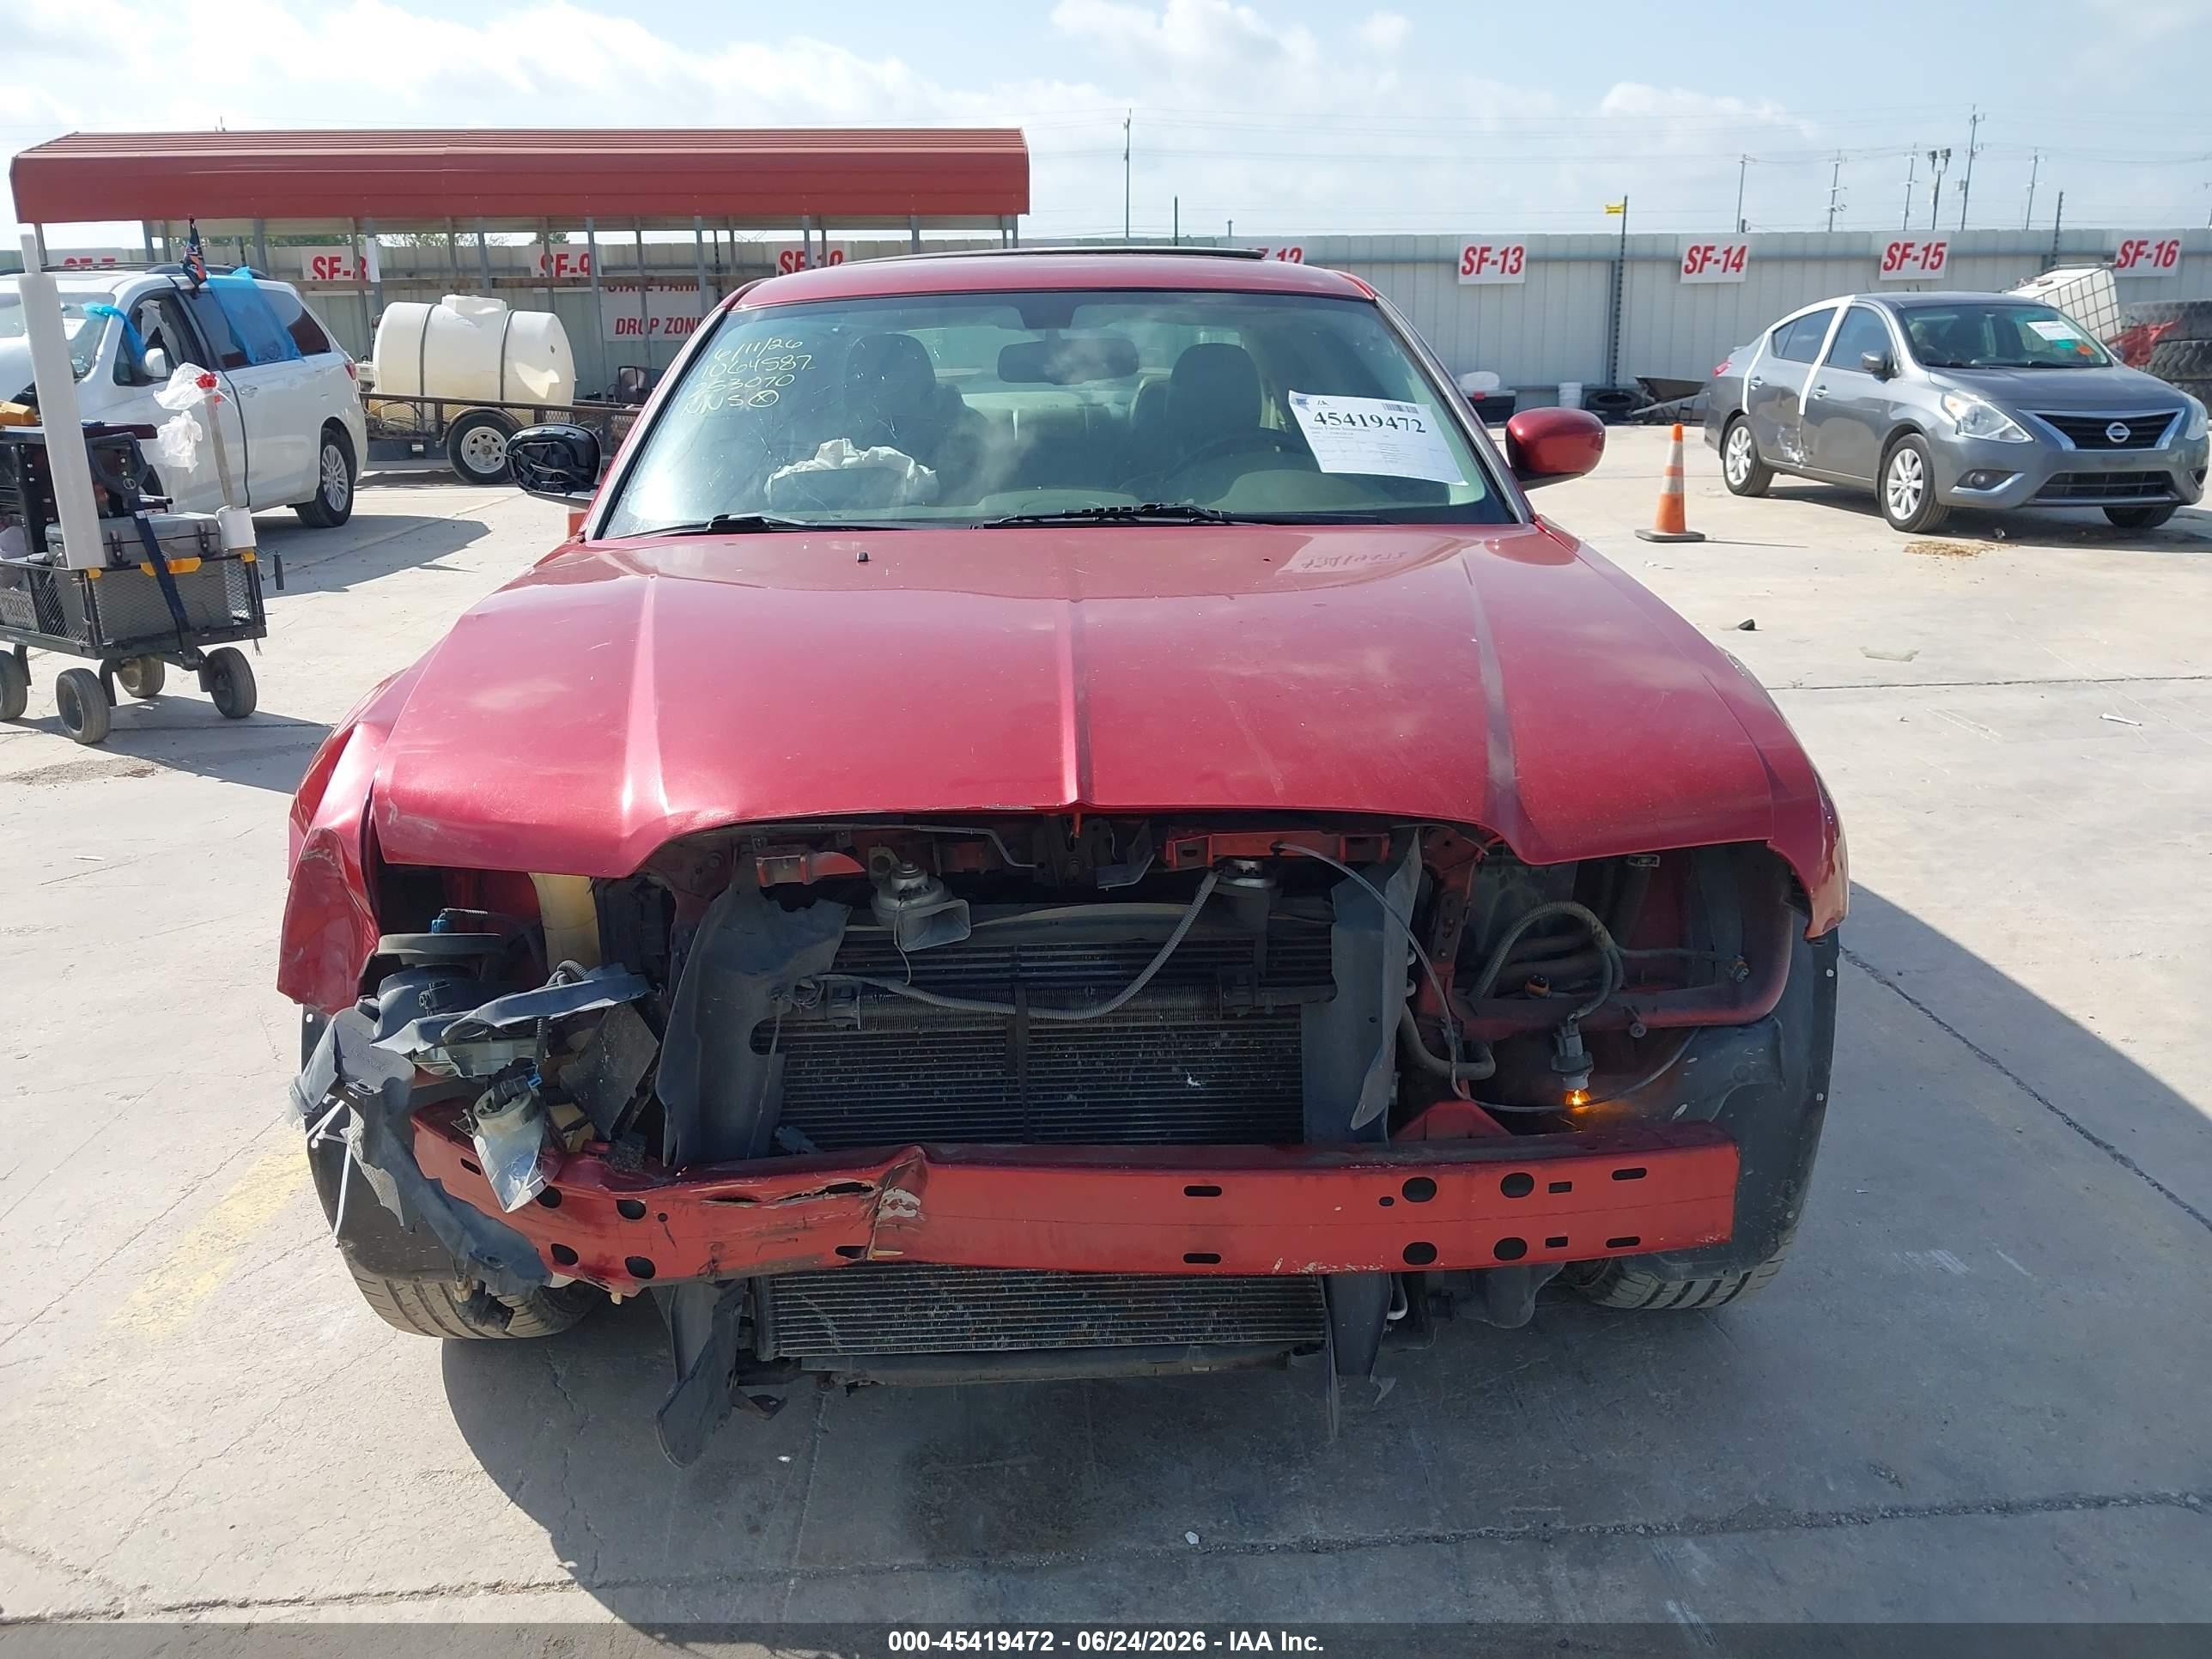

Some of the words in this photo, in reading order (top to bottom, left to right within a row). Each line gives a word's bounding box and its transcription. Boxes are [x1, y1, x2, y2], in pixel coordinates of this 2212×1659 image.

[780, 250, 843, 274] SF-0
[1462, 246, 1524, 275] SF-13
[1684, 245, 1747, 274] SF-14
[1883, 241, 1948, 270] SF-15
[2116, 240, 2179, 268] SF-16
[1314, 410, 1426, 434] 45419472
